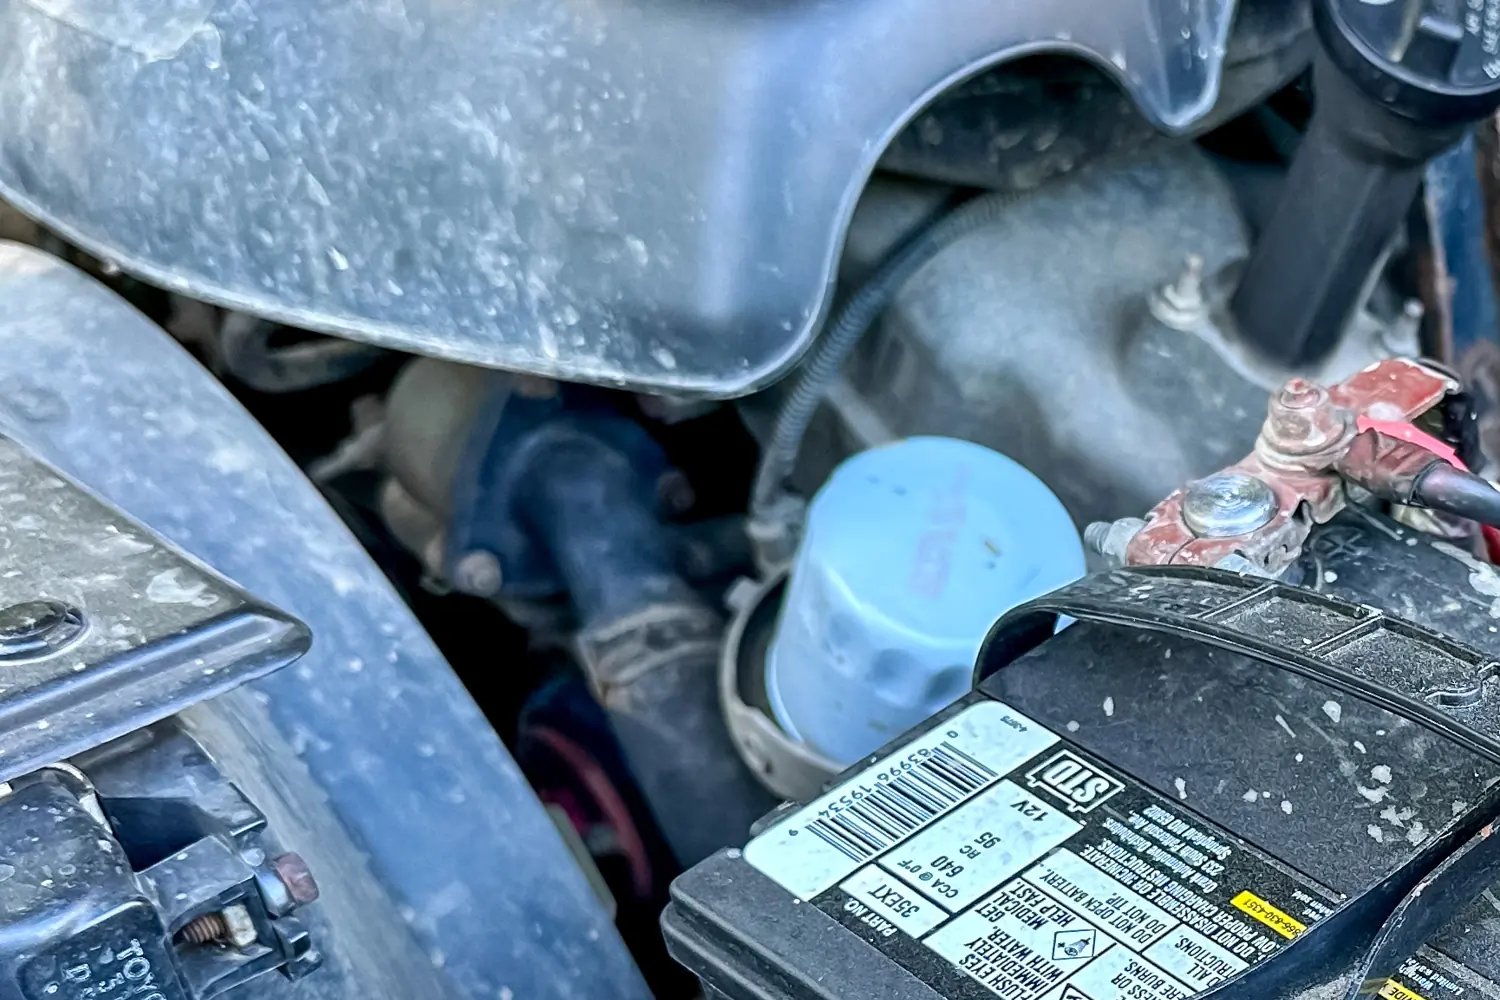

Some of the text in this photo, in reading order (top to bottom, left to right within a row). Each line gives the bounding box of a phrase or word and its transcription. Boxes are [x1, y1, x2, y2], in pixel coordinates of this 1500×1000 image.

[876, 748, 931, 782] 83996
[1043, 760, 1109, 802] STD
[818, 785, 872, 818] 19534
[1010, 800, 1048, 822] 12V
[959, 845, 981, 860] RC
[974, 831, 1001, 849] 95
[930, 855, 964, 878] 640
[867, 884, 920, 918] 35EXT
[931, 878, 959, 899] CCA
[1132, 879, 1154, 894] OR
[1164, 881, 1218, 917] CHARGING
[844, 897, 897, 937] PART NO.
[974, 903, 1006, 923] GET
[993, 892, 1048, 930] MEDICAL
[1009, 881, 1076, 928] HELP FAST.
[1039, 869, 1153, 944] DO NOT OPEN BATTERY.
[1105, 892, 1167, 935] DO NOT TIP.
[1147, 888, 1218, 935] DISASSEMBLE
[1211, 929, 1240, 948] NOT
[1212, 911, 1258, 941] PROPER
[964, 937, 1048, 993] IMMEDIATELY
[987, 926, 1064, 983] WITH WATER.
[1175, 935, 1236, 980] TRUCTIONS.
[1232, 941, 1256, 958] DO
[958, 953, 996, 980] EYES
[1110, 973, 1133, 989] OR
[1124, 958, 1166, 990] BURNS.
[1186, 962, 1212, 981] ALL
